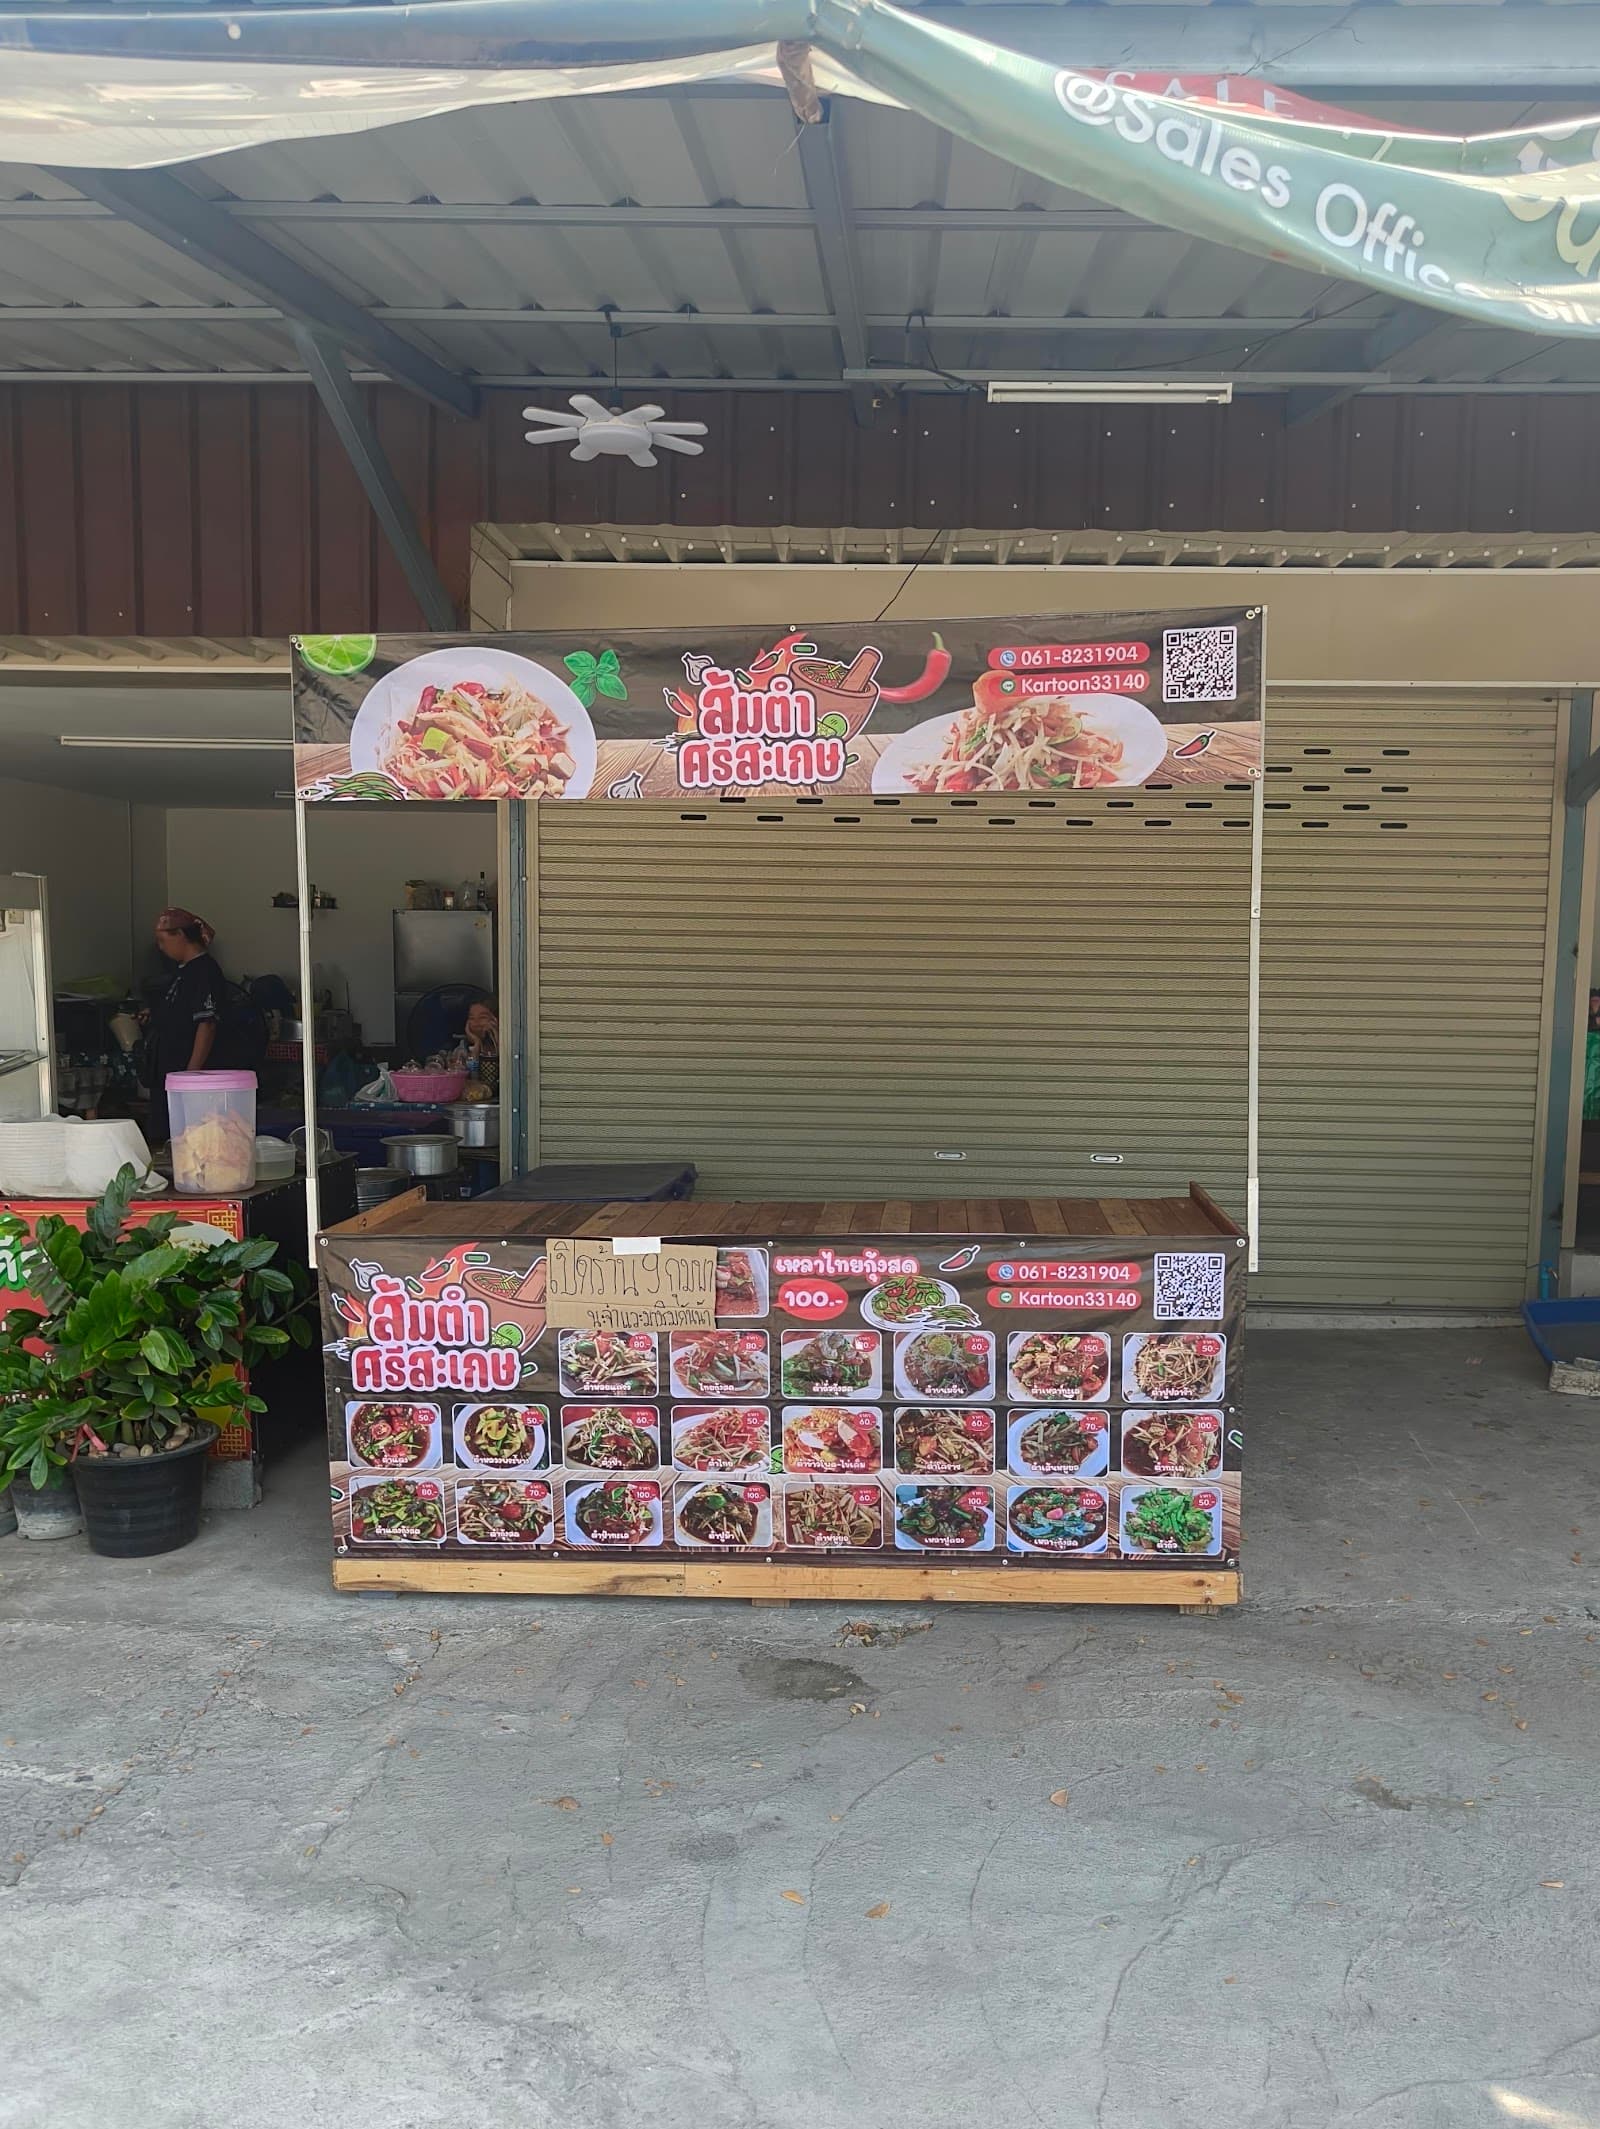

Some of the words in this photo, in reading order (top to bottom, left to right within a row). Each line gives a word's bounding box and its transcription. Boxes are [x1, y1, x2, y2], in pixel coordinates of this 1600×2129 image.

[1054, 69, 1293, 209] @Sales
[1020, 645, 1138, 666] 061-8231904
[1020, 673, 1146, 694] Kartoon33140
[702, 670, 812, 736] ส้มตำ
[682, 738, 841, 785] ศรีสะเกษ
[775, 1250, 919, 1283] เหลาไทยกุ้งสด
[641, 1253, 661, 1294] 9
[1018, 1265, 1131, 1281] 061-8231904
[784, 1290, 844, 1308] 100.-
[1018, 1291, 1138, 1307] Kartoon33140
[372, 1278, 486, 1343] ส้มตำ
[971, 1343, 988, 1351] 60.-
[1083, 1344, 1105, 1352] 150.-
[1201, 1345, 1220, 1353] 50.-
[354, 1347, 518, 1390] ศรีสะเกษ
[698, 1382, 735, 1394] ไทยกุ้งสด
[858, 1418, 876, 1426] 60.-
[1085, 1423, 1102, 1431] 70.-
[1197, 1421, 1217, 1429] 100.-
[708, 1458, 734, 1467] ตำไทย
[1154, 1461, 1185, 1472] ตำทะเล
[529, 1489, 545, 1497] 70.-
[636, 1491, 656, 1499] 100.-
[859, 1494, 876, 1502] 60.-
[1082, 1498, 1103, 1506] 100.-
